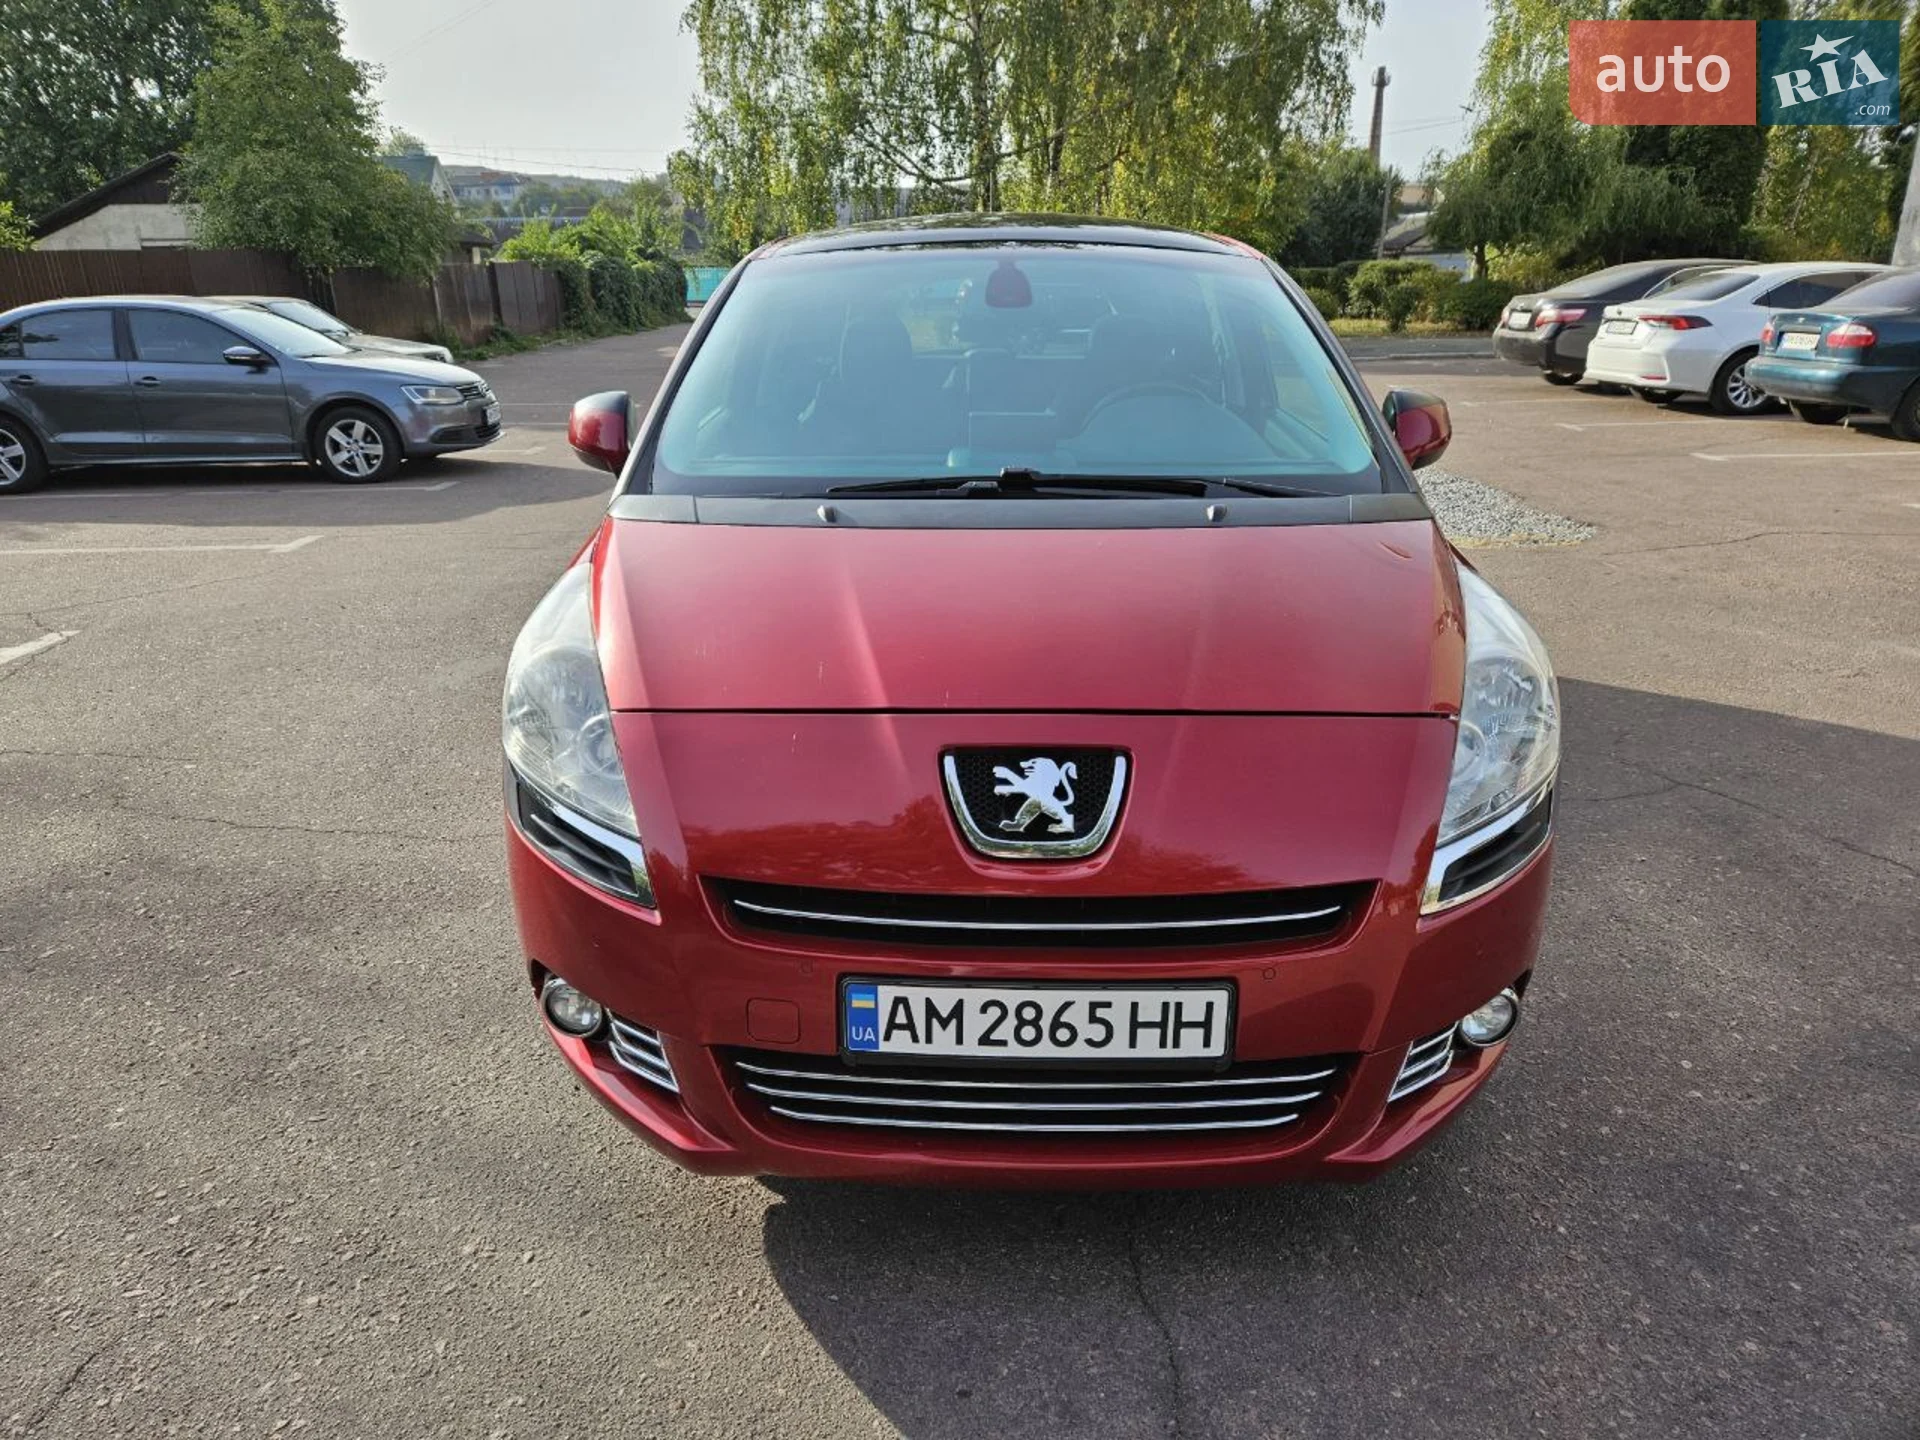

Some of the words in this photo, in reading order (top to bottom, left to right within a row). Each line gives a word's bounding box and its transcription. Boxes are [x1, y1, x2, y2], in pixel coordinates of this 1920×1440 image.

[851, 1026, 876, 1042] UA
[883, 996, 964, 1045] AM
[977, 999, 1114, 1049] 2865
[1129, 1001, 1214, 1050] HH
